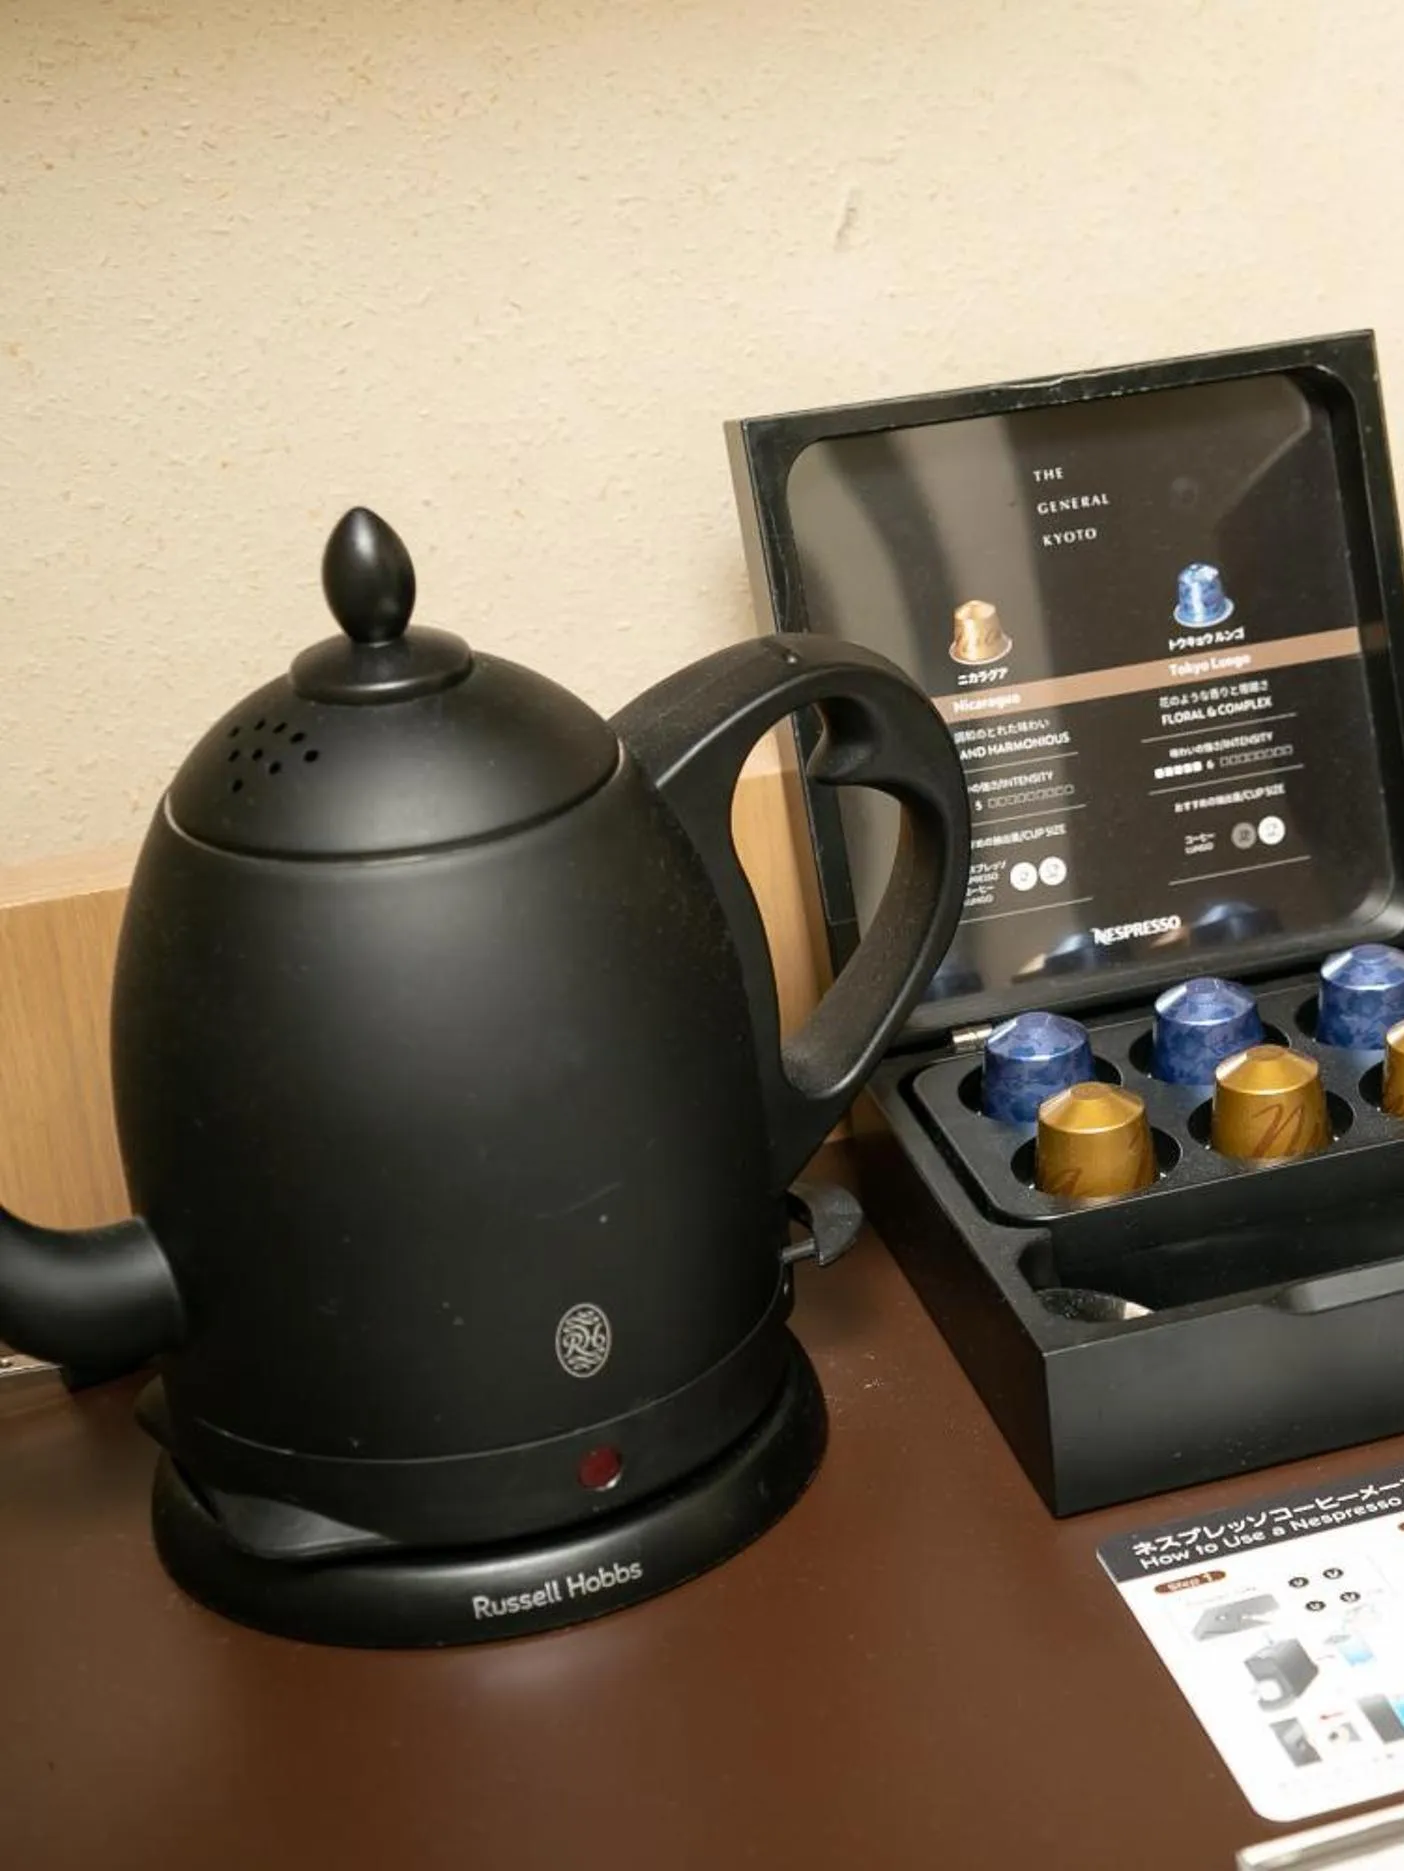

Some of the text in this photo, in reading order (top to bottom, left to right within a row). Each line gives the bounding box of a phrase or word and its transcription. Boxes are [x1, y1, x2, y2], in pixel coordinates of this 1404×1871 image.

[1033, 466, 1064, 482] THE
[1037, 493, 1110, 515] GENERAL
[1043, 528, 1097, 546] KYOTO
[957, 667, 1009, 686] ニカラグア
[1168, 654, 1252, 676] Tokyo Lungo
[1161, 695, 1273, 726] FLORAL & COMPLEX
[960, 730, 1071, 760] AND HARMONIOUS
[1089, 914, 1181, 946] NESPRESSO
[1140, 1549, 1189, 1570] How
[1195, 1543, 1219, 1556] to
[1223, 1530, 1266, 1548] Use
[1271, 1526, 1286, 1537] a
[1288, 1496, 1403, 1532] Nespresso
[471, 1561, 643, 1620] Russell Hobbs
